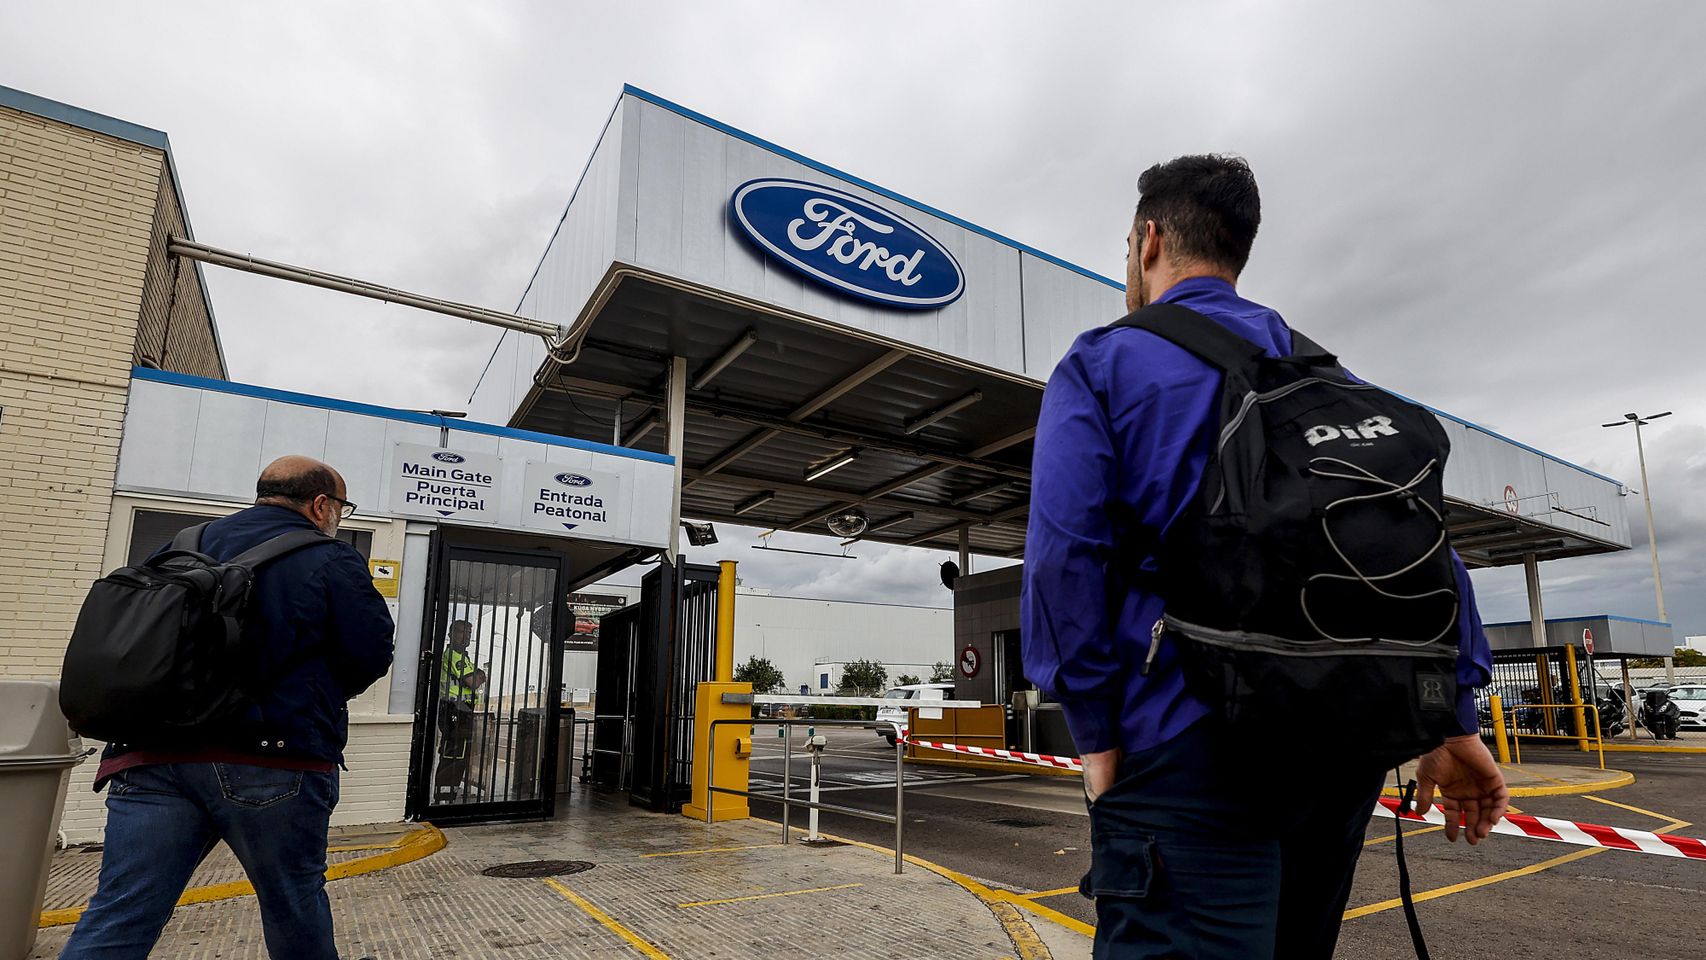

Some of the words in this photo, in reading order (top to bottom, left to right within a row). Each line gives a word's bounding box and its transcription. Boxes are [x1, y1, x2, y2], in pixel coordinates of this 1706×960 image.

[787, 198, 925, 286] Ford
[437, 452, 460, 463] Ford
[402, 463, 447, 478] Main
[451, 469, 492, 484] Gate
[560, 474, 586, 485] Ford
[417, 481, 476, 498] Puerta
[539, 488, 603, 508] Entrada
[406, 492, 485, 511] Principal
[534, 502, 607, 523] Peatonal
